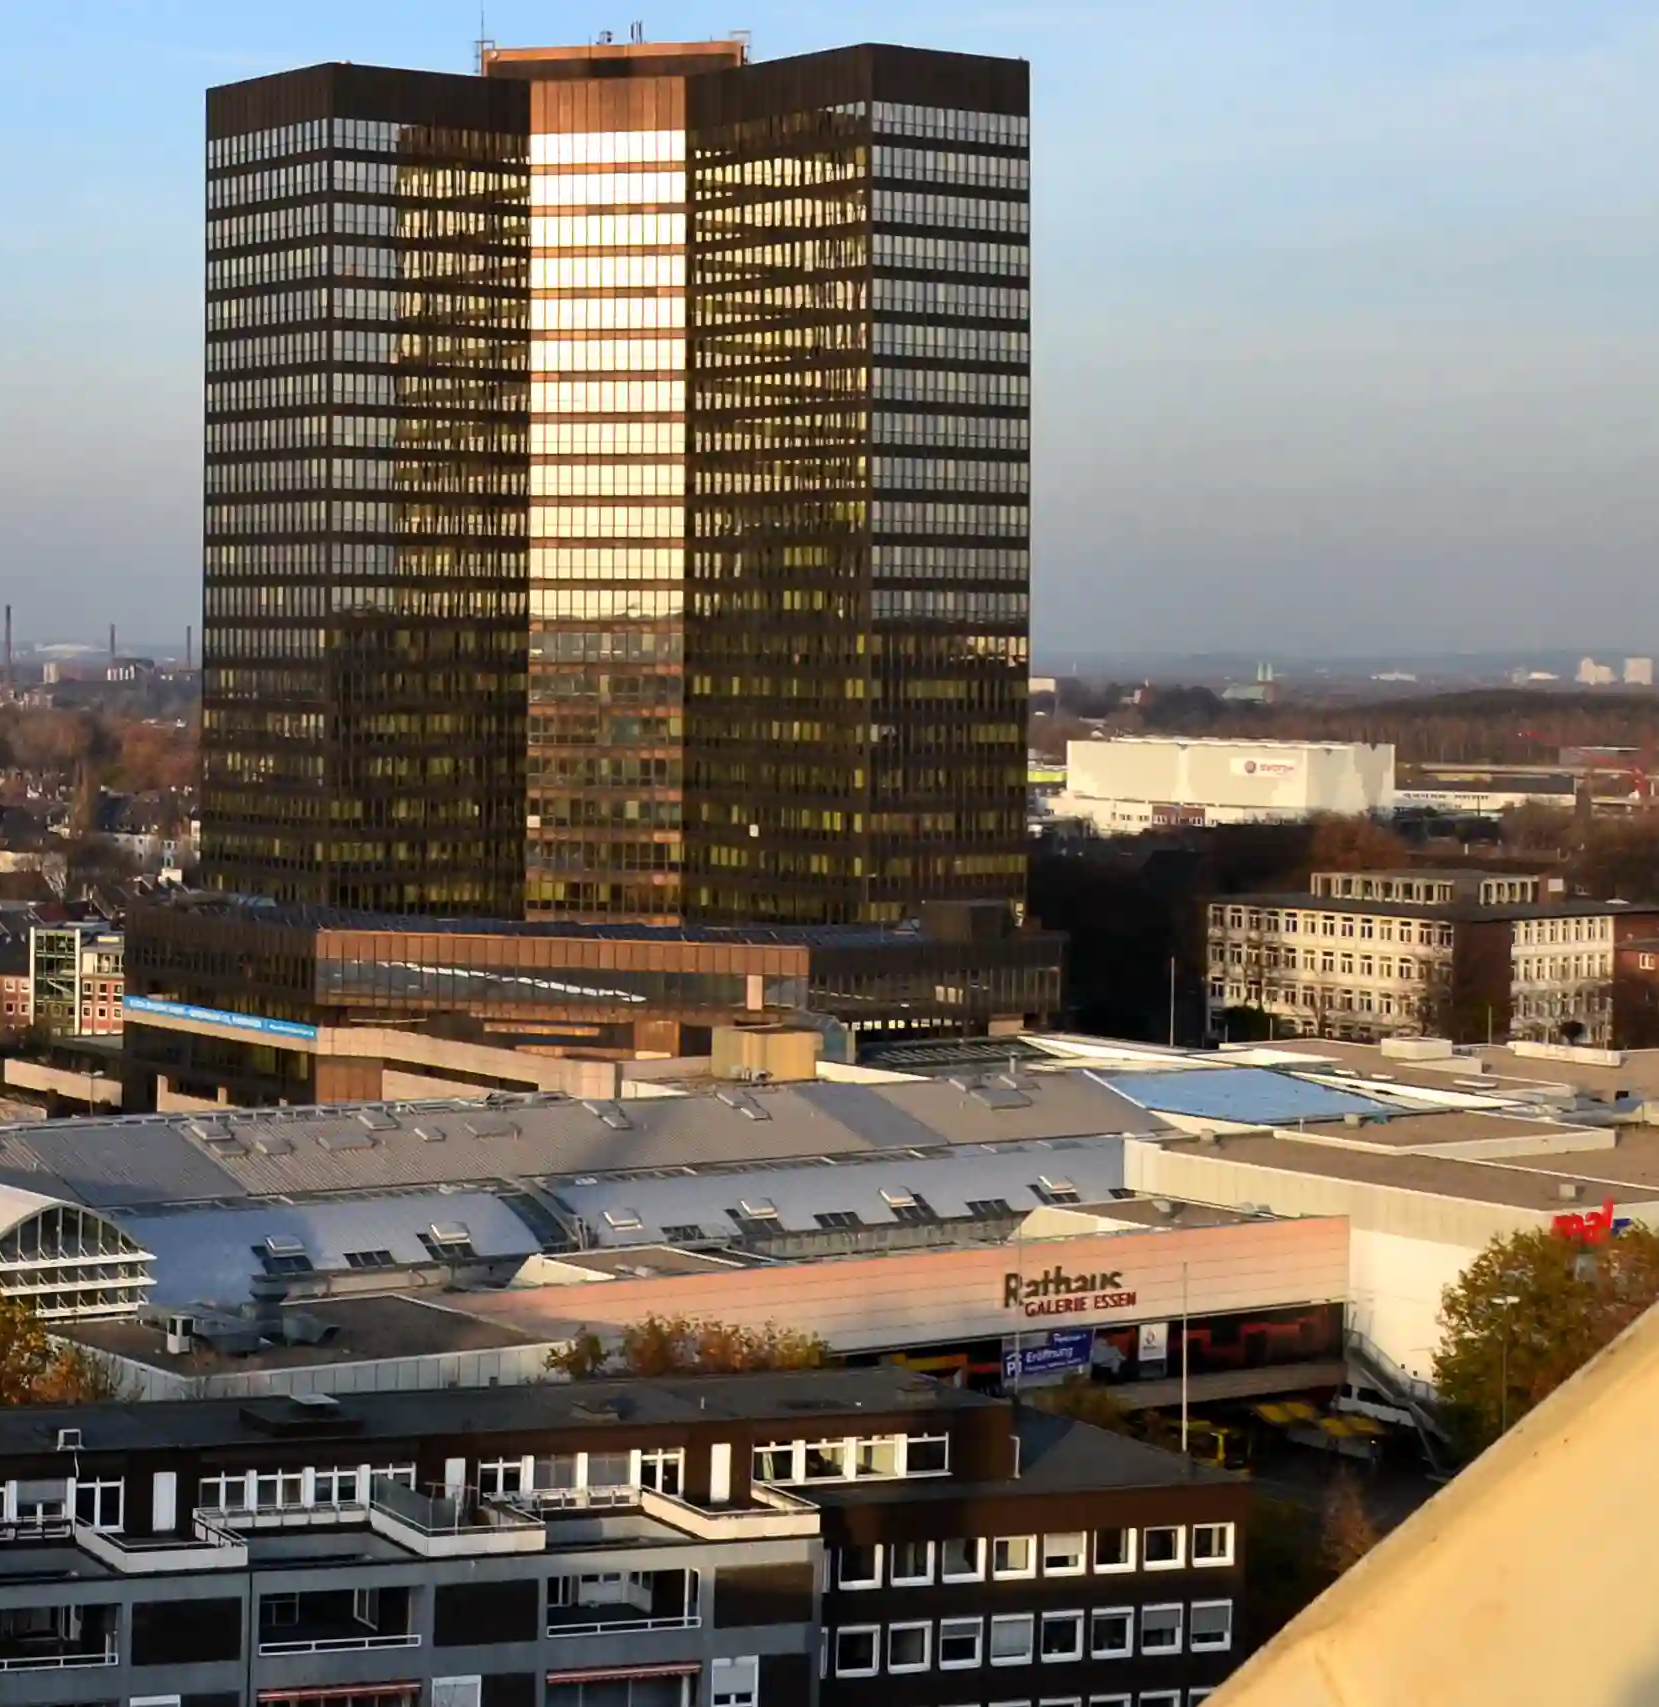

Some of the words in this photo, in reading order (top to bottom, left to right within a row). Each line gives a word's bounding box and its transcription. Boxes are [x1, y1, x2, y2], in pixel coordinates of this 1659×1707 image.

[1004, 1265, 1124, 1308] Rathaus
[1025, 1297, 1088, 1317] GALERIE
[1094, 1291, 1137, 1310] ESSEN
